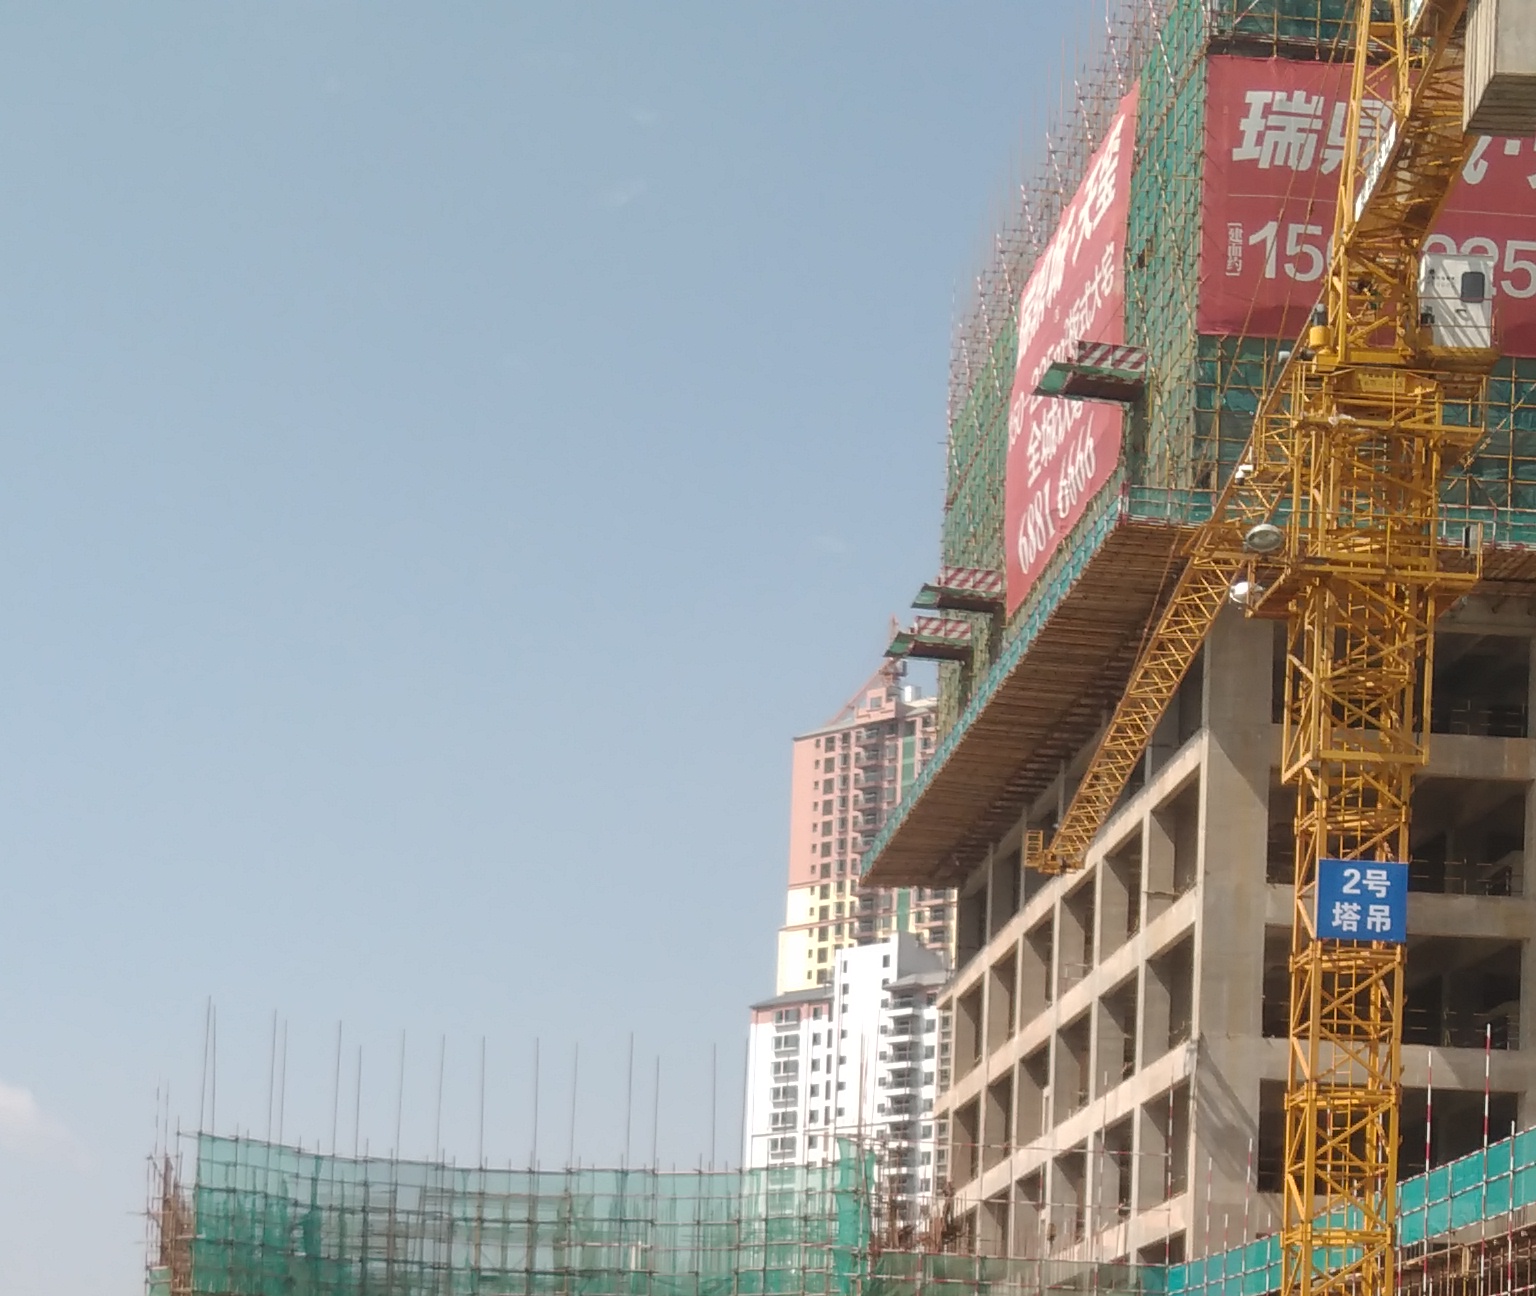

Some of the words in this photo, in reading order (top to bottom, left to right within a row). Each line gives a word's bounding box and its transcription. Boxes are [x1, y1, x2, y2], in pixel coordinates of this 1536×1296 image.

[1018, 478, 1056, 574] 6881
[1342, 868, 1391, 898] 2号
[1331, 901, 1391, 932] 塔吊
